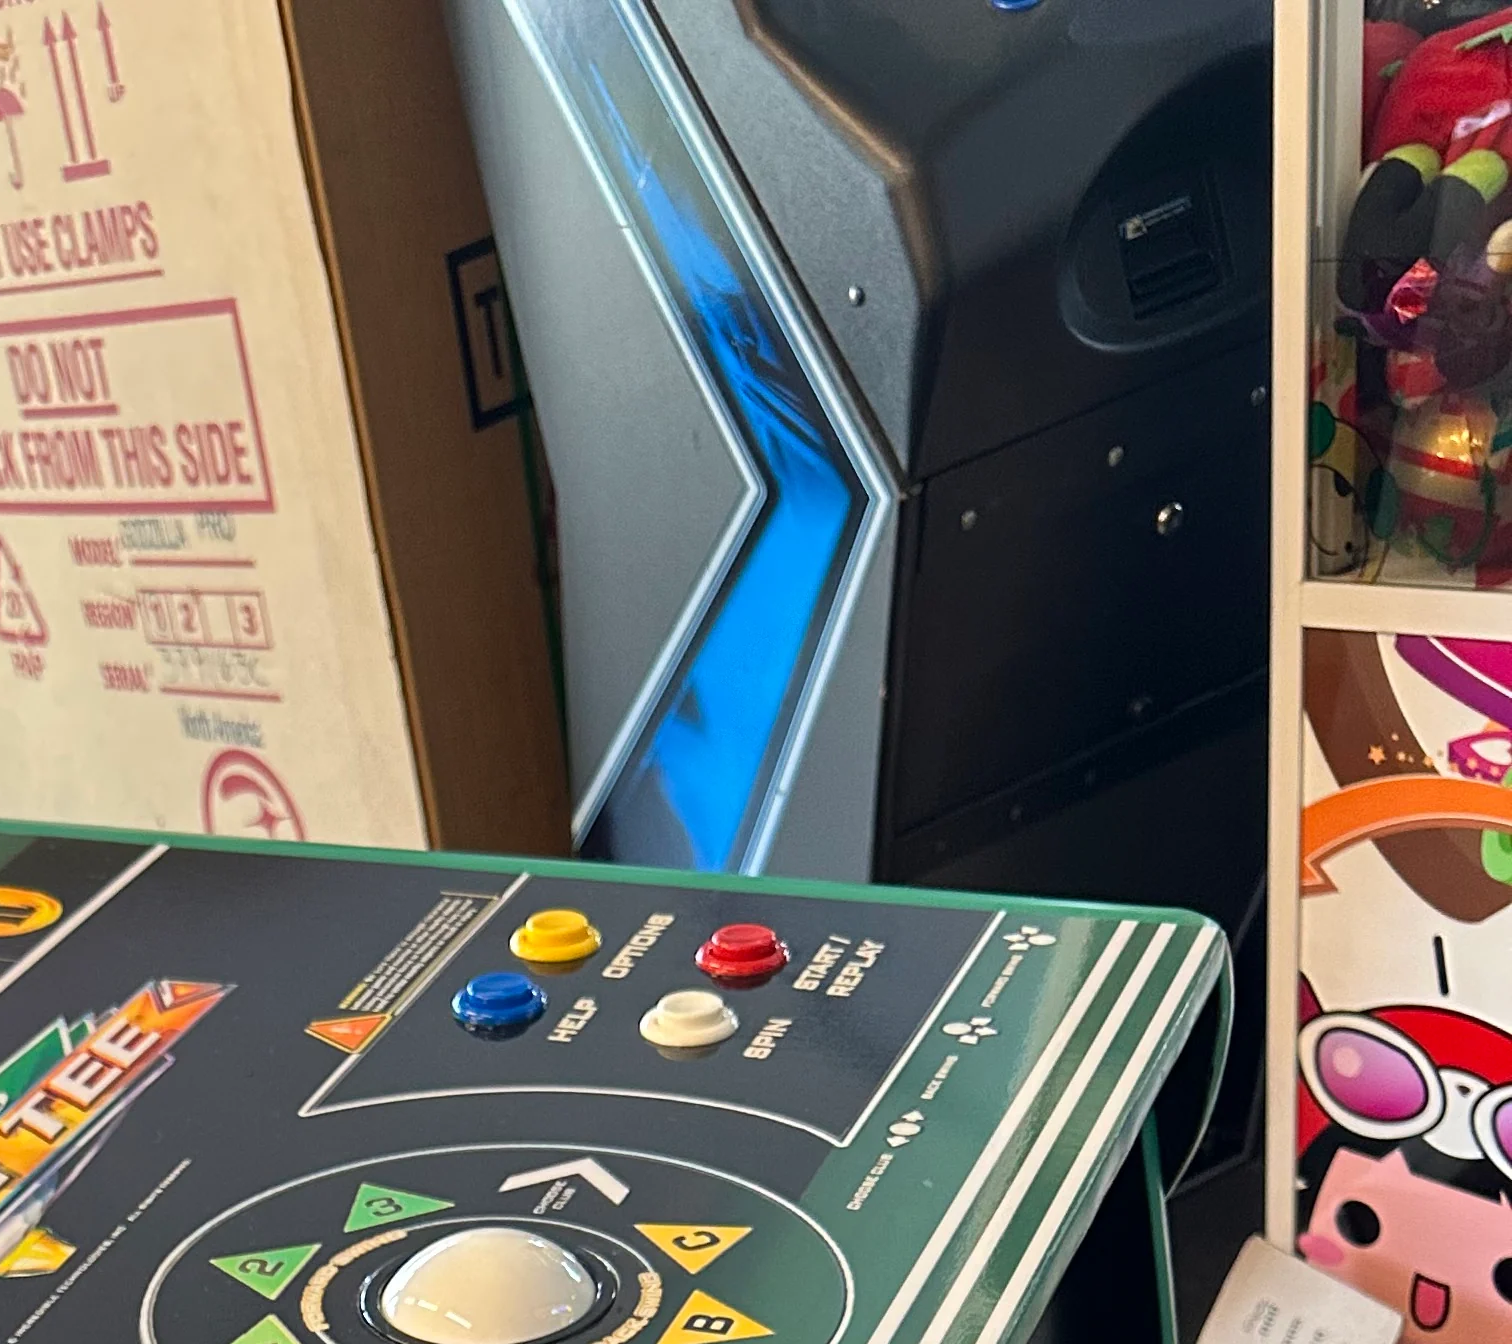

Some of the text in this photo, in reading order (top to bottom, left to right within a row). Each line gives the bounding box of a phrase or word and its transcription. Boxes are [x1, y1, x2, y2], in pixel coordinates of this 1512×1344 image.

[0, 217, 54, 277] USE
[50, 200, 161, 270] CLAMPS
[6, 338, 112, 404] DO NOT
[19, 429, 105, 490] FROM
[98, 423, 175, 489] THIS
[175, 421, 255, 485] SIDE
[178, 602, 198, 633] 2
[240, 603, 259, 636] 3
[601, 912, 676, 980] OPTIONS
[792, 941, 845, 993] START
[825, 937, 886, 998] REPLAY
[547, 996, 598, 1044] HELP
[743, 1018, 792, 1061] SPIN
[364, 1195, 408, 1218] 3
[532, 1179, 568, 1215] CHOOSE
[551, 1187, 577, 1211] CLUB
[673, 1229, 721, 1253] C
[238, 1257, 285, 1280] 2
[683, 1313, 734, 1337] B
